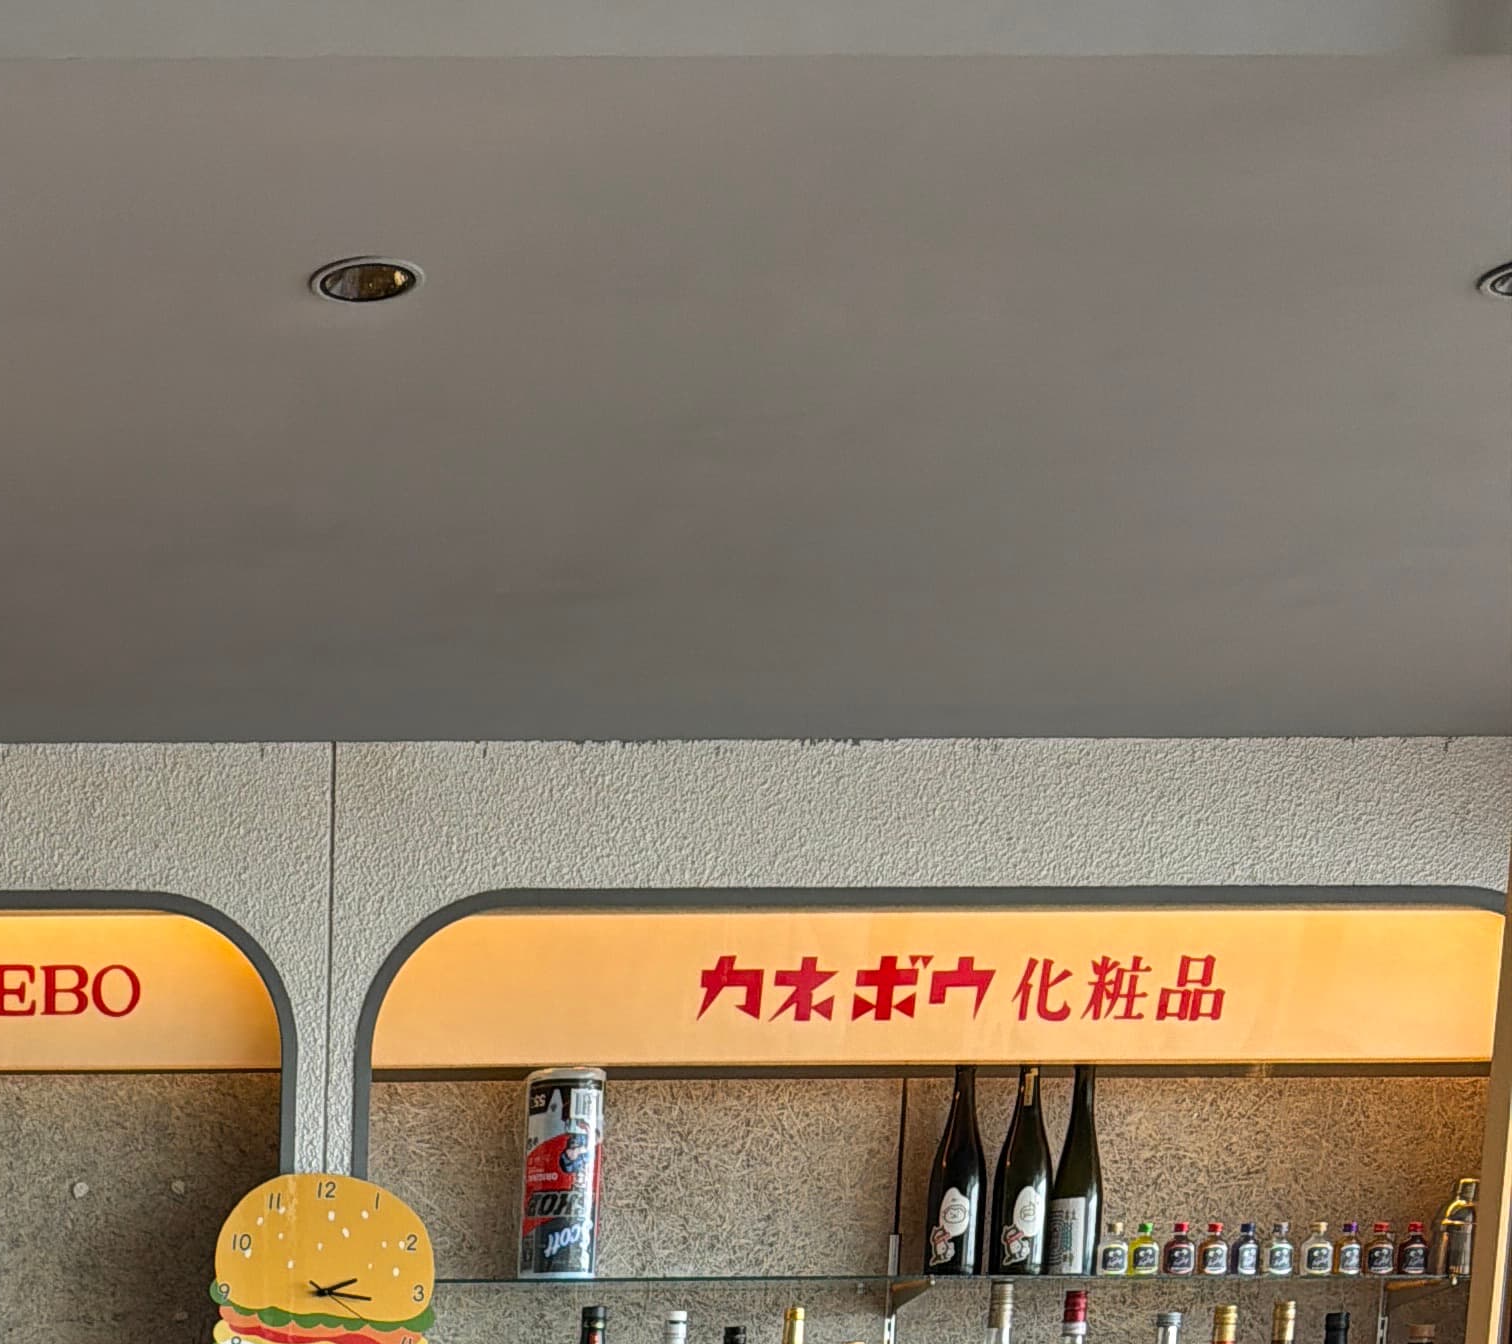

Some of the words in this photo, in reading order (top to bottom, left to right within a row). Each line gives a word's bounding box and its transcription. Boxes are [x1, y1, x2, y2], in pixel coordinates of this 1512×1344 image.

[696, 955, 1225, 1022] カネボウ化粧品
[317, 1181, 336, 1198] 12
[269, 1193, 281, 1210] 11
[232, 1234, 251, 1250] 10
[406, 1235, 417, 1251] 2
[544, 1217, 594, 1259] Scott
[219, 1284, 230, 1300] 9
[413, 1285, 424, 1301] 3
